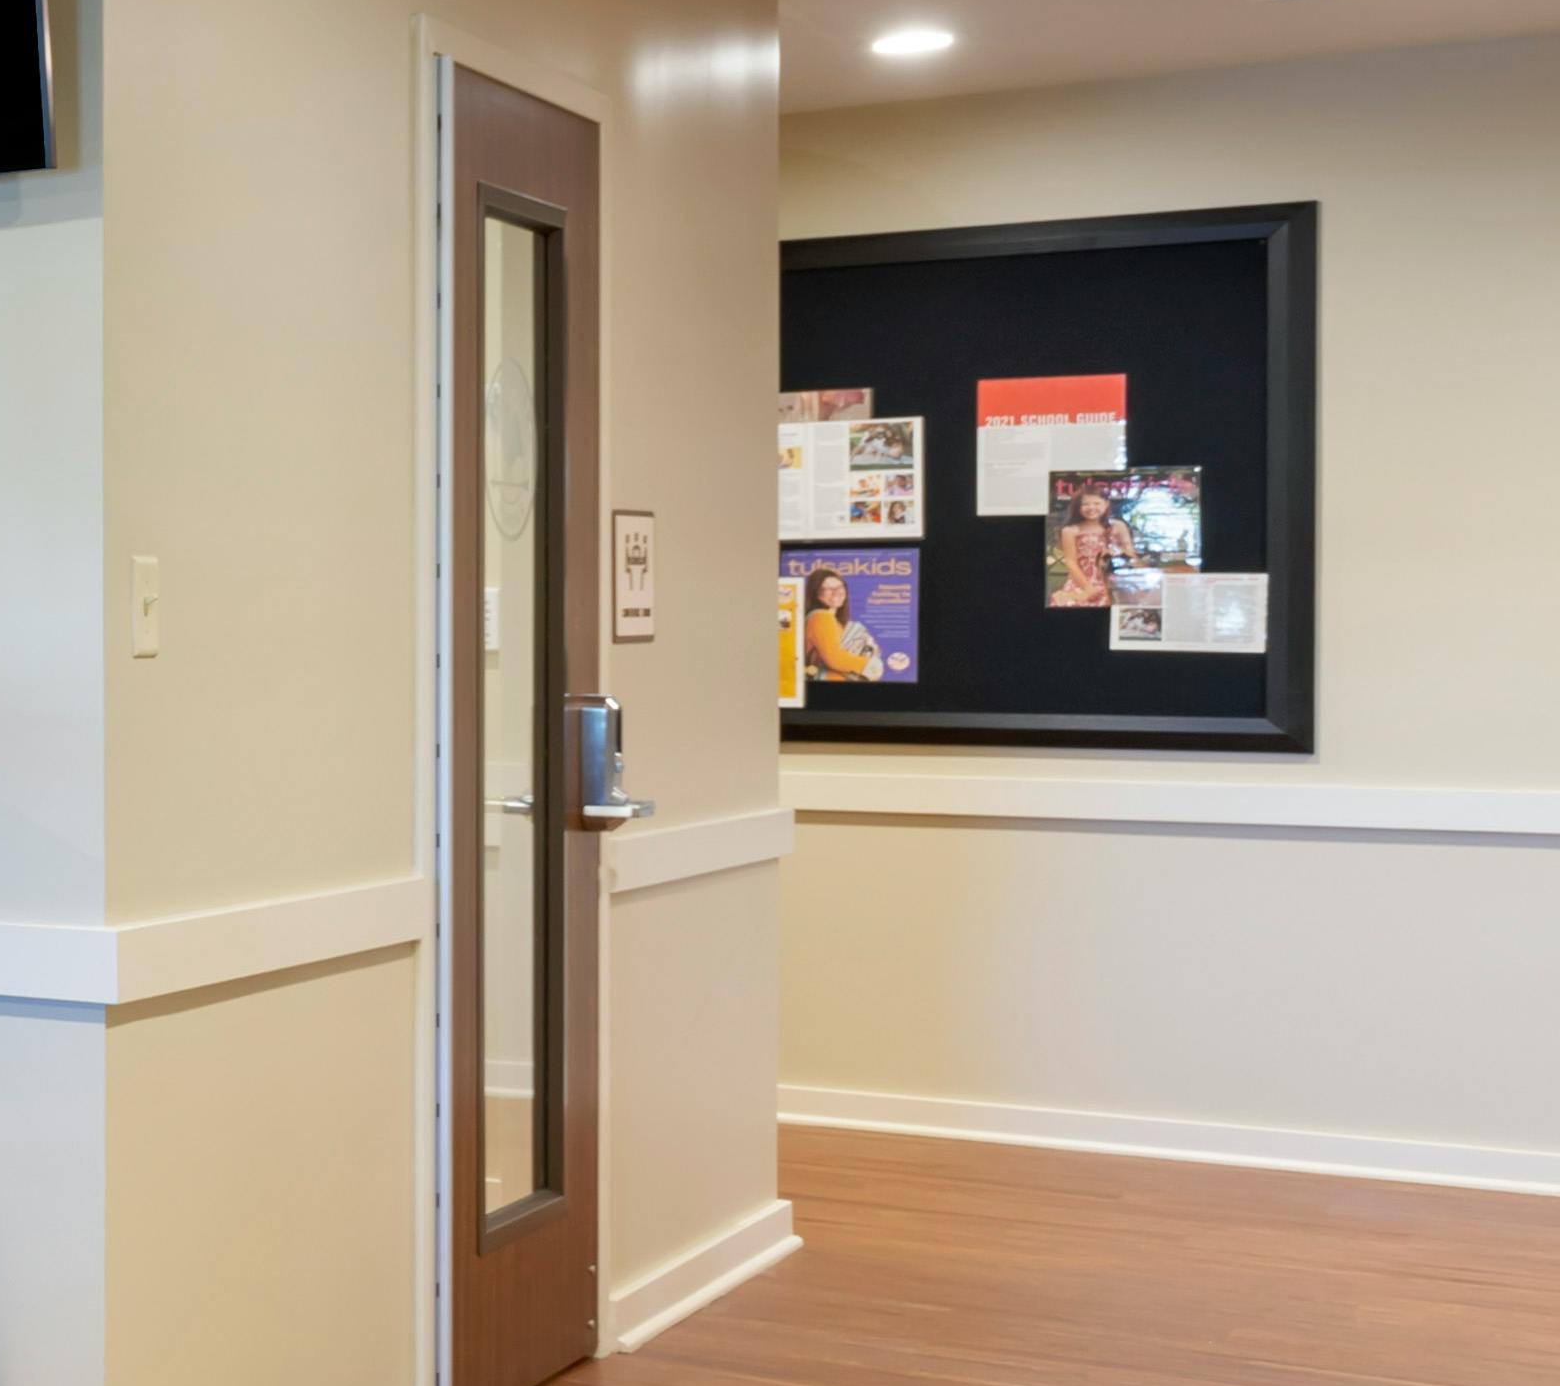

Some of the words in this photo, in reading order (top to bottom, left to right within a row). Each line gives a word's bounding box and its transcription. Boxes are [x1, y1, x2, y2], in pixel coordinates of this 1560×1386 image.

[984, 414, 1016, 429] 2021
[1020, 412, 1070, 426] SCHOOL
[1076, 410, 1116, 424] GUIDE
